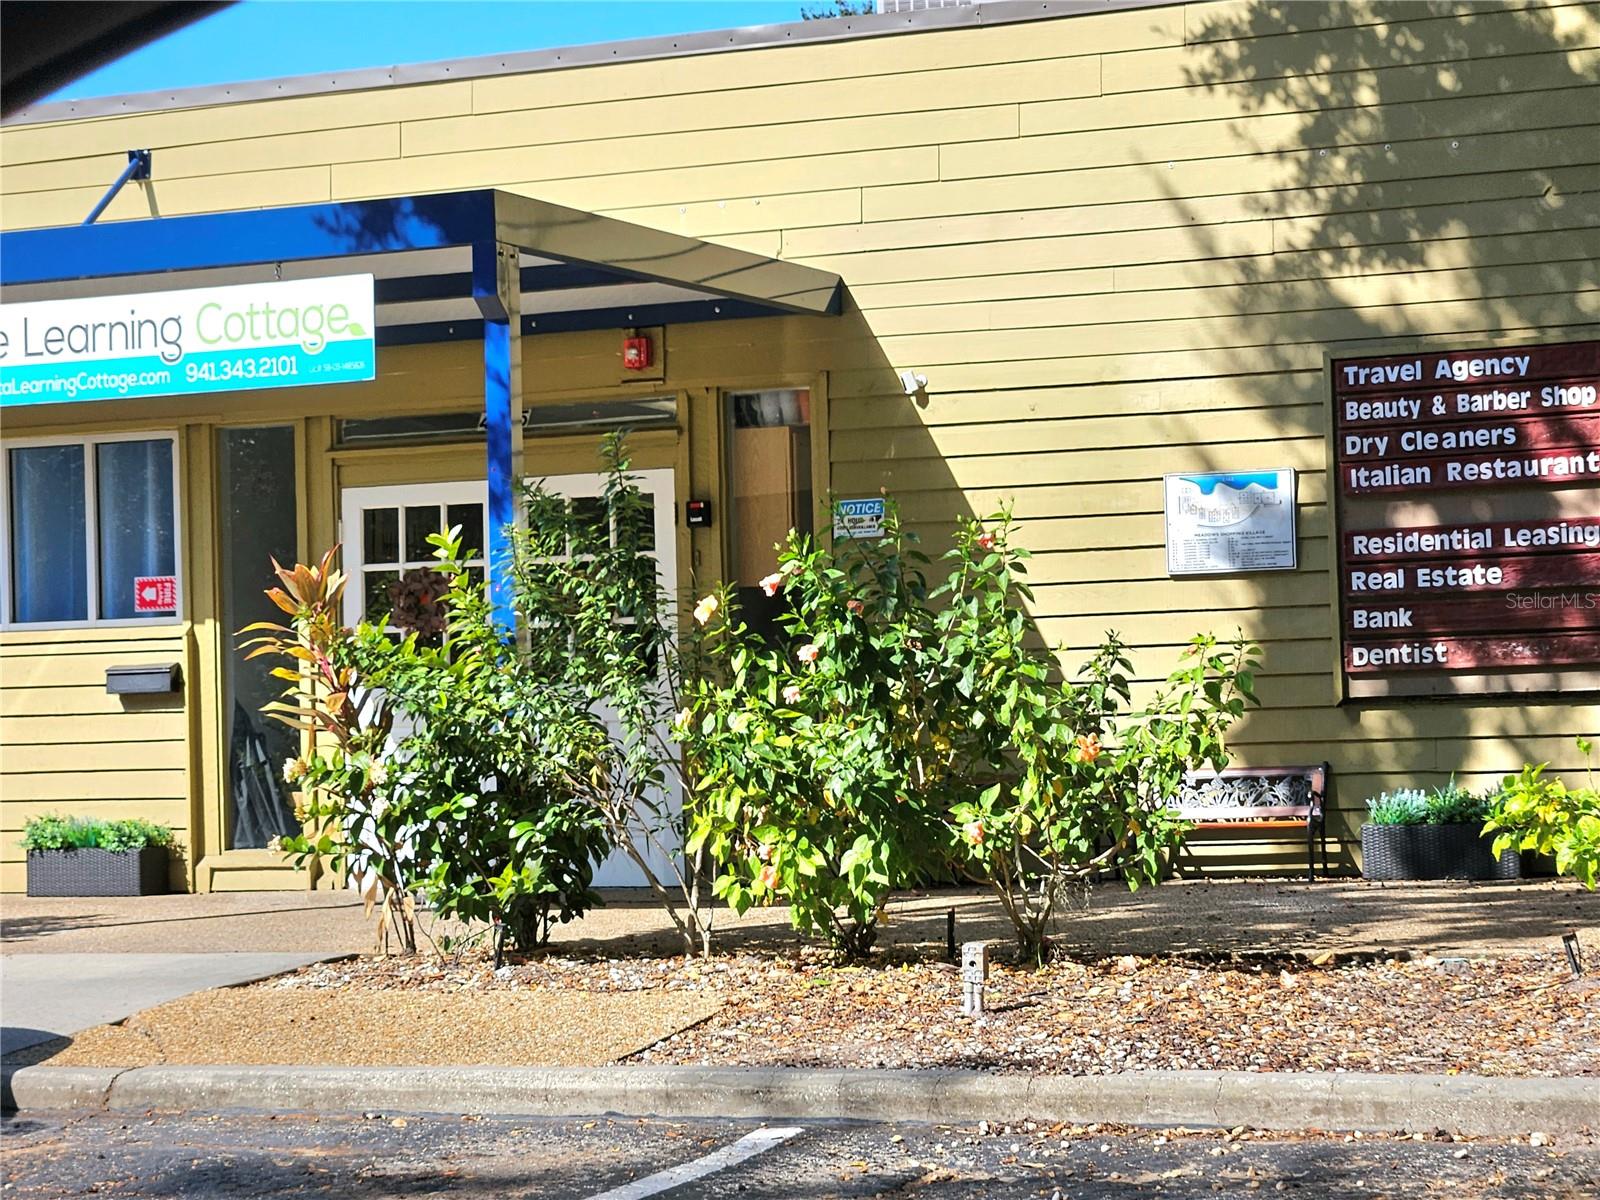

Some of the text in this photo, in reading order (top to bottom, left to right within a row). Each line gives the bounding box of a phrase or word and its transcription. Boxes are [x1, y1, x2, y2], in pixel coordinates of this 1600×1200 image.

[24, 309, 183, 363] Learning
[196, 302, 349, 352] Cottage
[185, 355, 298, 383] 941.343.2101
[1344, 356, 1530, 385] Travel Agency
[1345, 385, 1597, 421] Beauty & Barber Shop
[1345, 427, 1516, 456] Dry Cleaners
[1350, 452, 1600, 488] Italian Restaurant
[840, 503, 881, 514] NOTICE
[1353, 522, 1600, 555] Residential Leasing
[1351, 564, 1503, 591] Real Estate
[1353, 608, 1413, 629] Bank
[1352, 643, 1448, 667] Dentist
